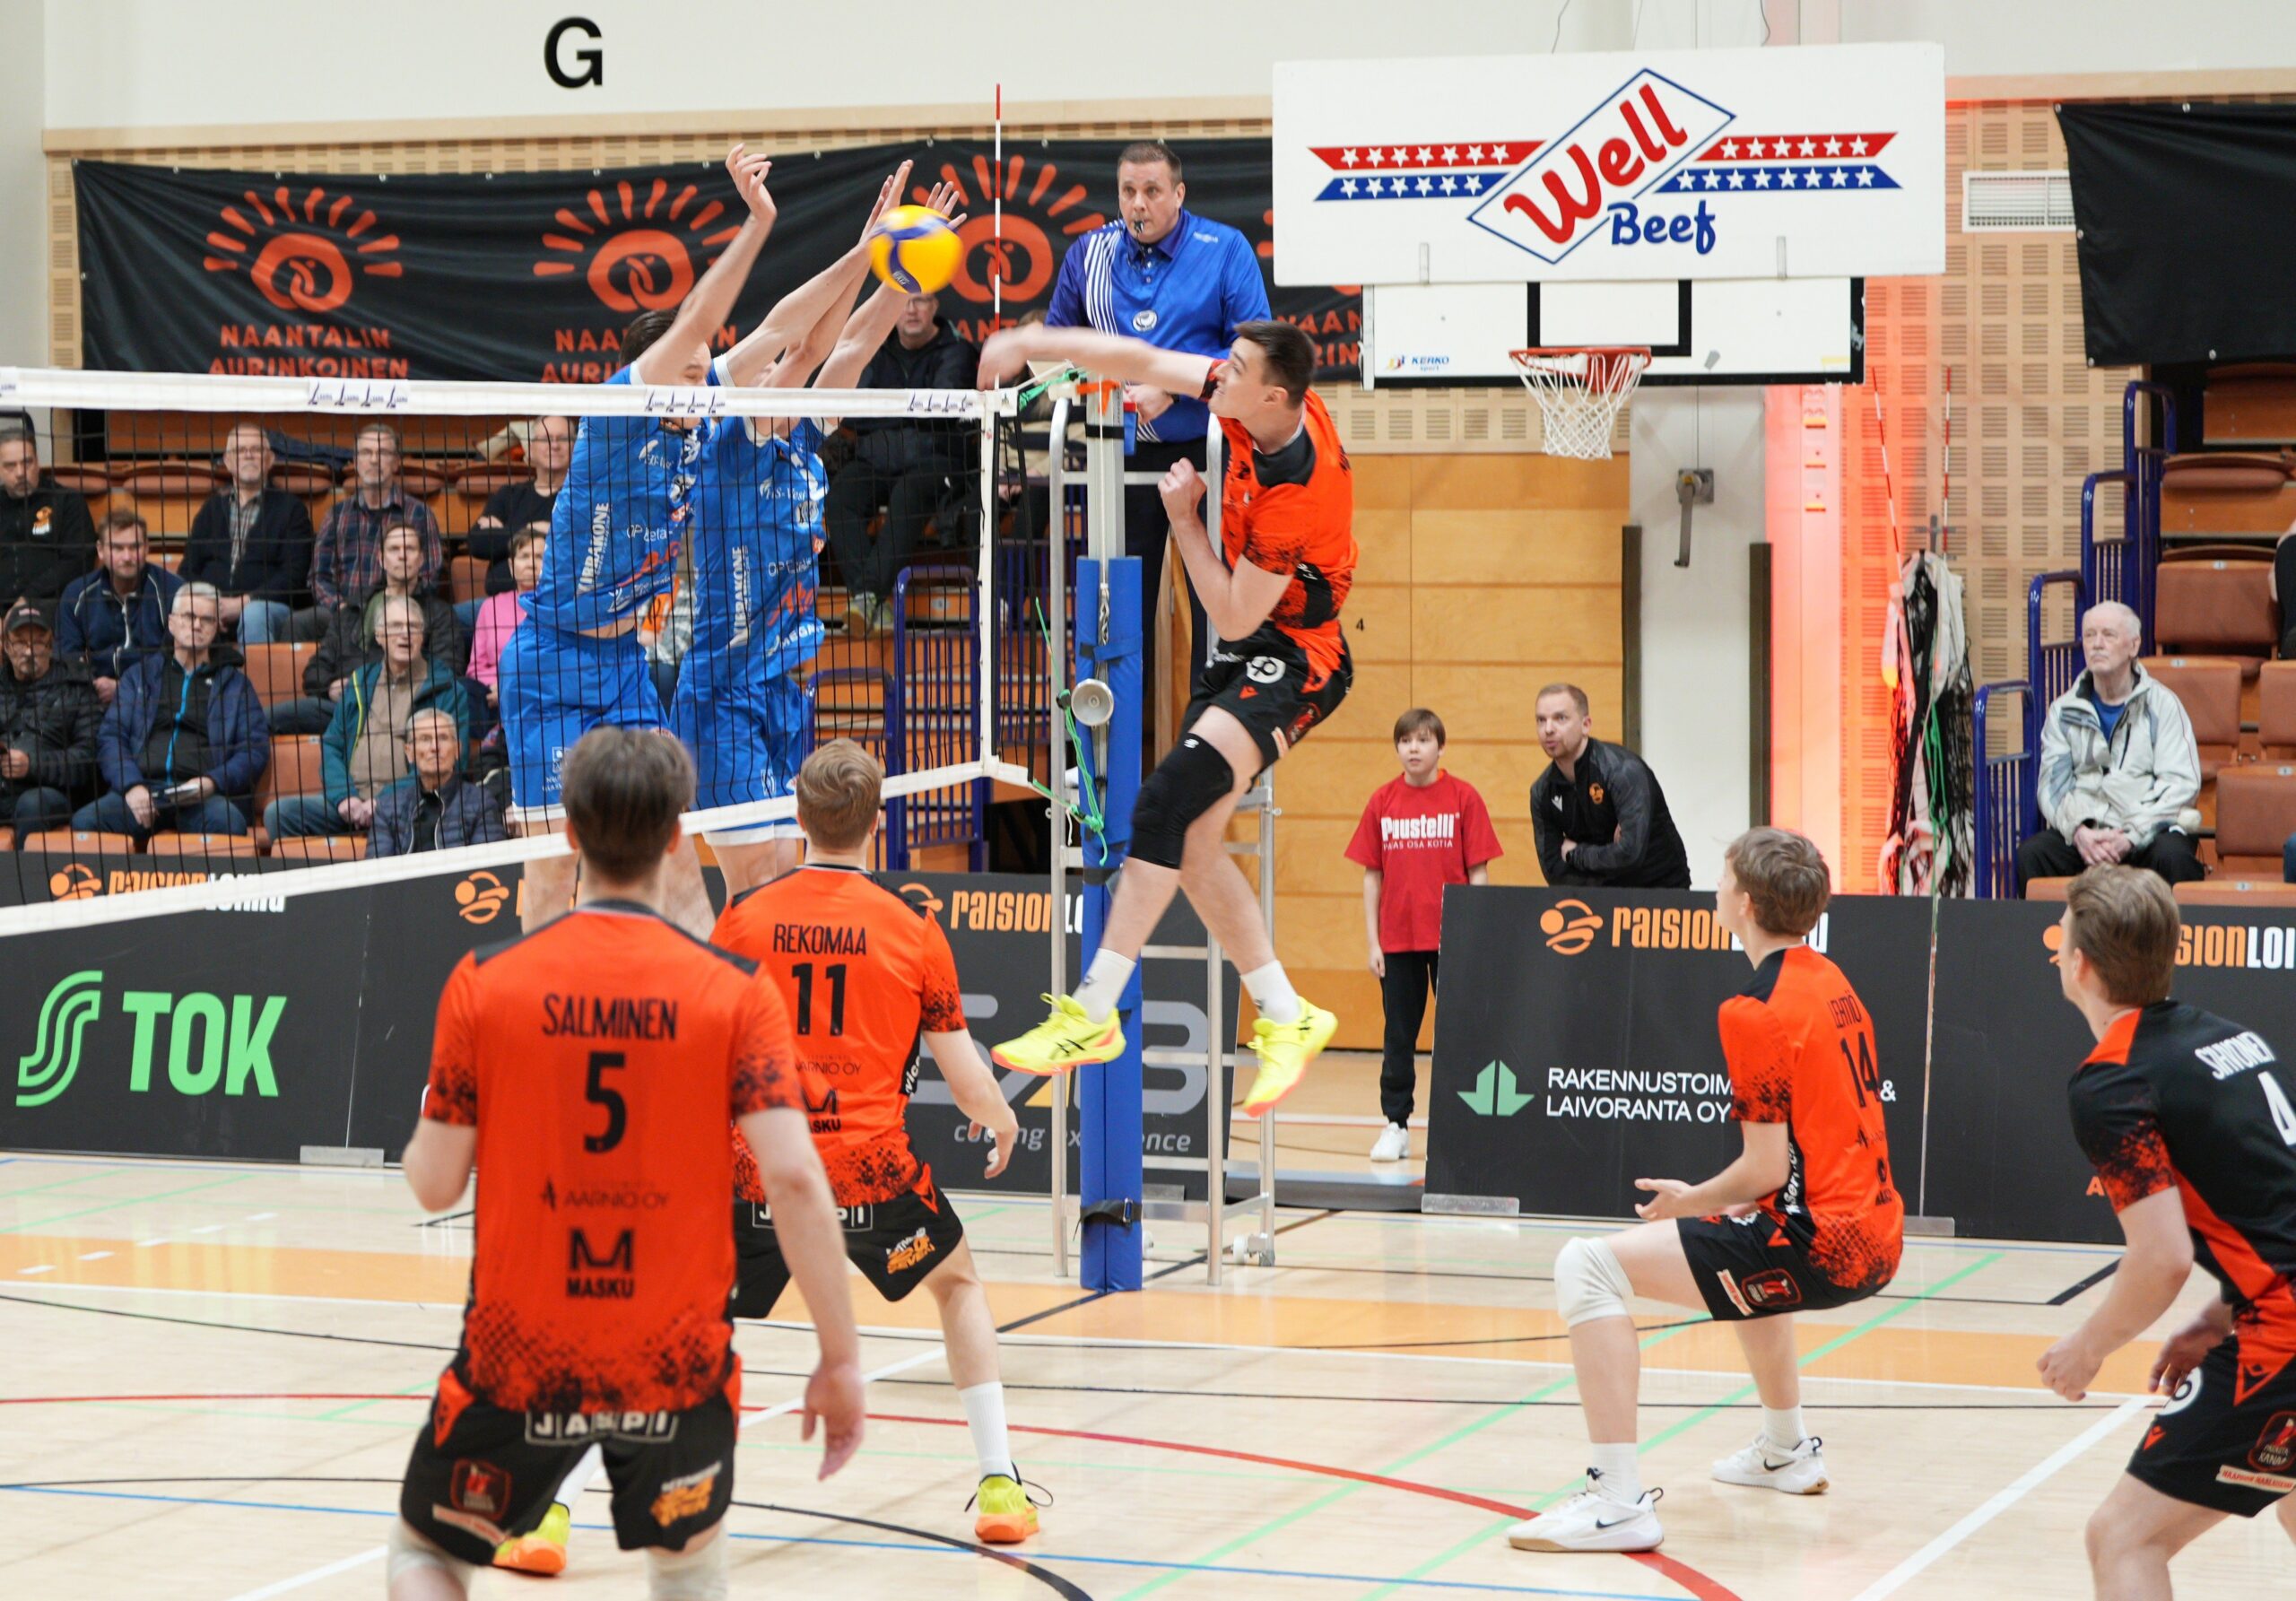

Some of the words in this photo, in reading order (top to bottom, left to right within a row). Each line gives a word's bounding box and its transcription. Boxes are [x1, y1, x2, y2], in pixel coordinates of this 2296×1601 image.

[544, 17, 604, 89] G
[1503, 83, 1688, 244] Well
[1607, 199, 1716, 255] Beef
[221, 324, 390, 349] NAANTALIN
[208, 356, 409, 379] AURINKOINEN
[1380, 812, 1455, 842] Puustelli
[773, 924, 866, 955] REKOMAA
[542, 993, 677, 1041] SALMINEN
[792, 963, 847, 1036] 11
[122, 990, 287, 1097] TOK
[842, 1062, 862, 1075] OY
[1548, 1067, 1733, 1096] RAKENNUSTOIM
[1880, 1079, 1896, 1101] &
[1840, 1031, 1880, 1108] 14
[585, 1051, 627, 1154] 5
[1546, 1095, 1692, 1121] LAIVORANTA
[1697, 1101, 1731, 1123] OY
[567, 1277, 634, 1298] MASKU
